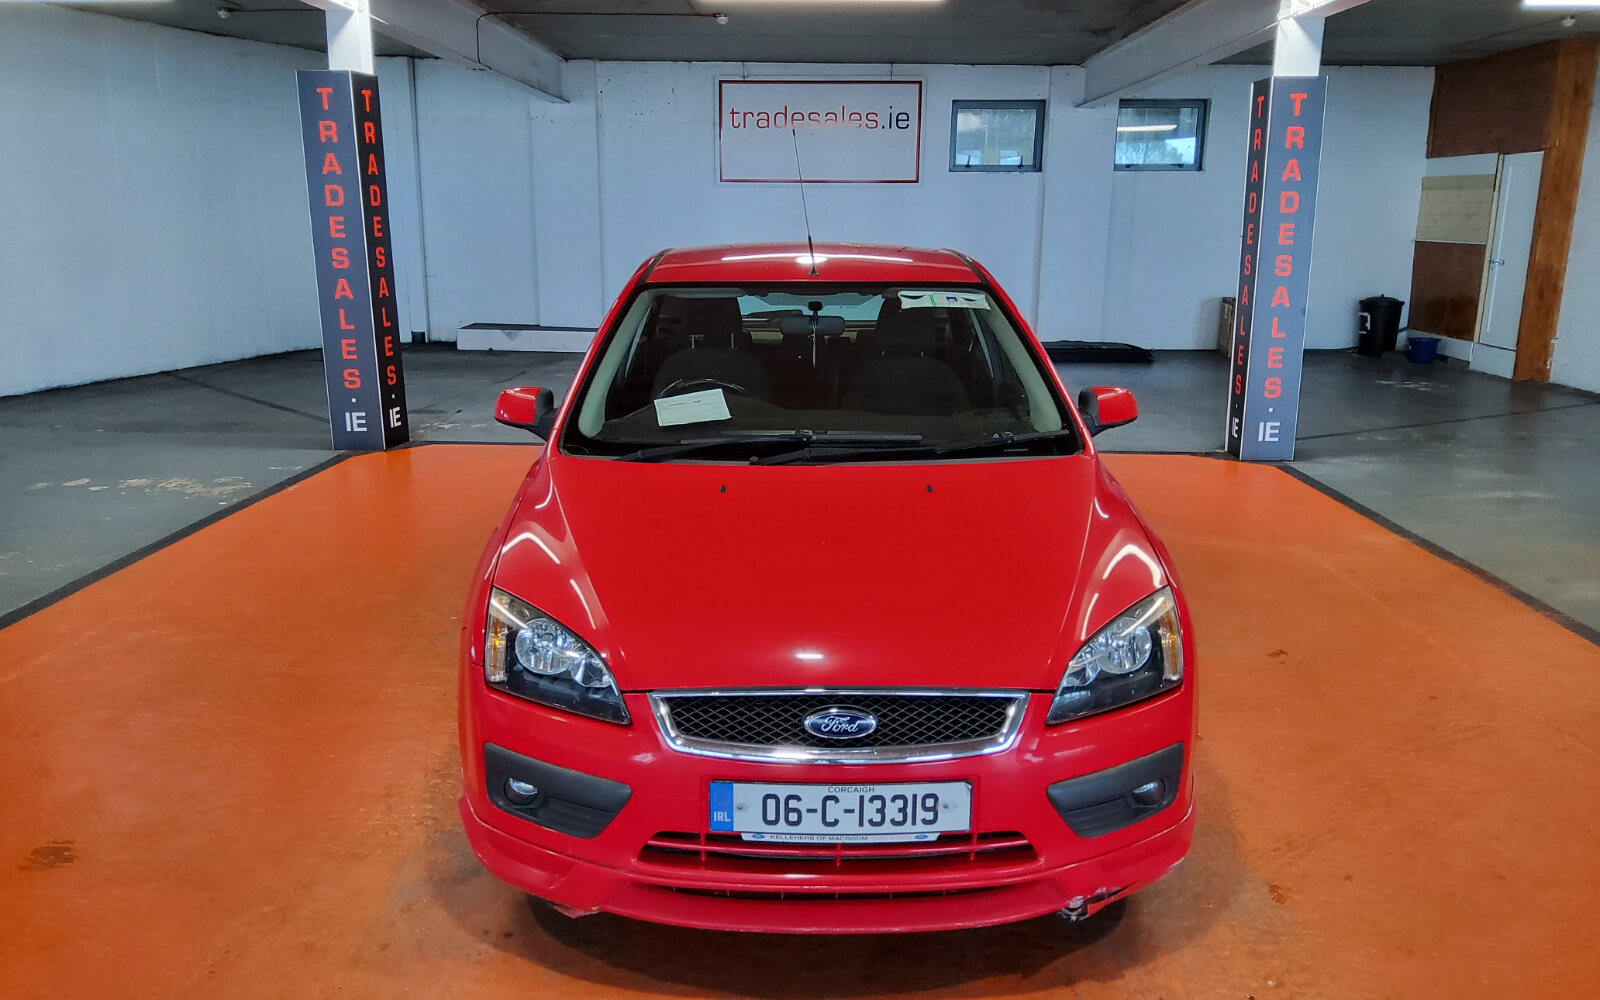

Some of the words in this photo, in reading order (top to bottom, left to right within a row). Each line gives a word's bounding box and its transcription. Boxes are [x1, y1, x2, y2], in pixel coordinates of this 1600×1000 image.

[729, 104, 910, 130] tradesales.ie
[820, 715, 859, 734] Ford
[827, 786, 875, 794] CORCAIGH
[713, 811, 731, 823] IRL
[761, 793, 940, 828] 06-C-13319
